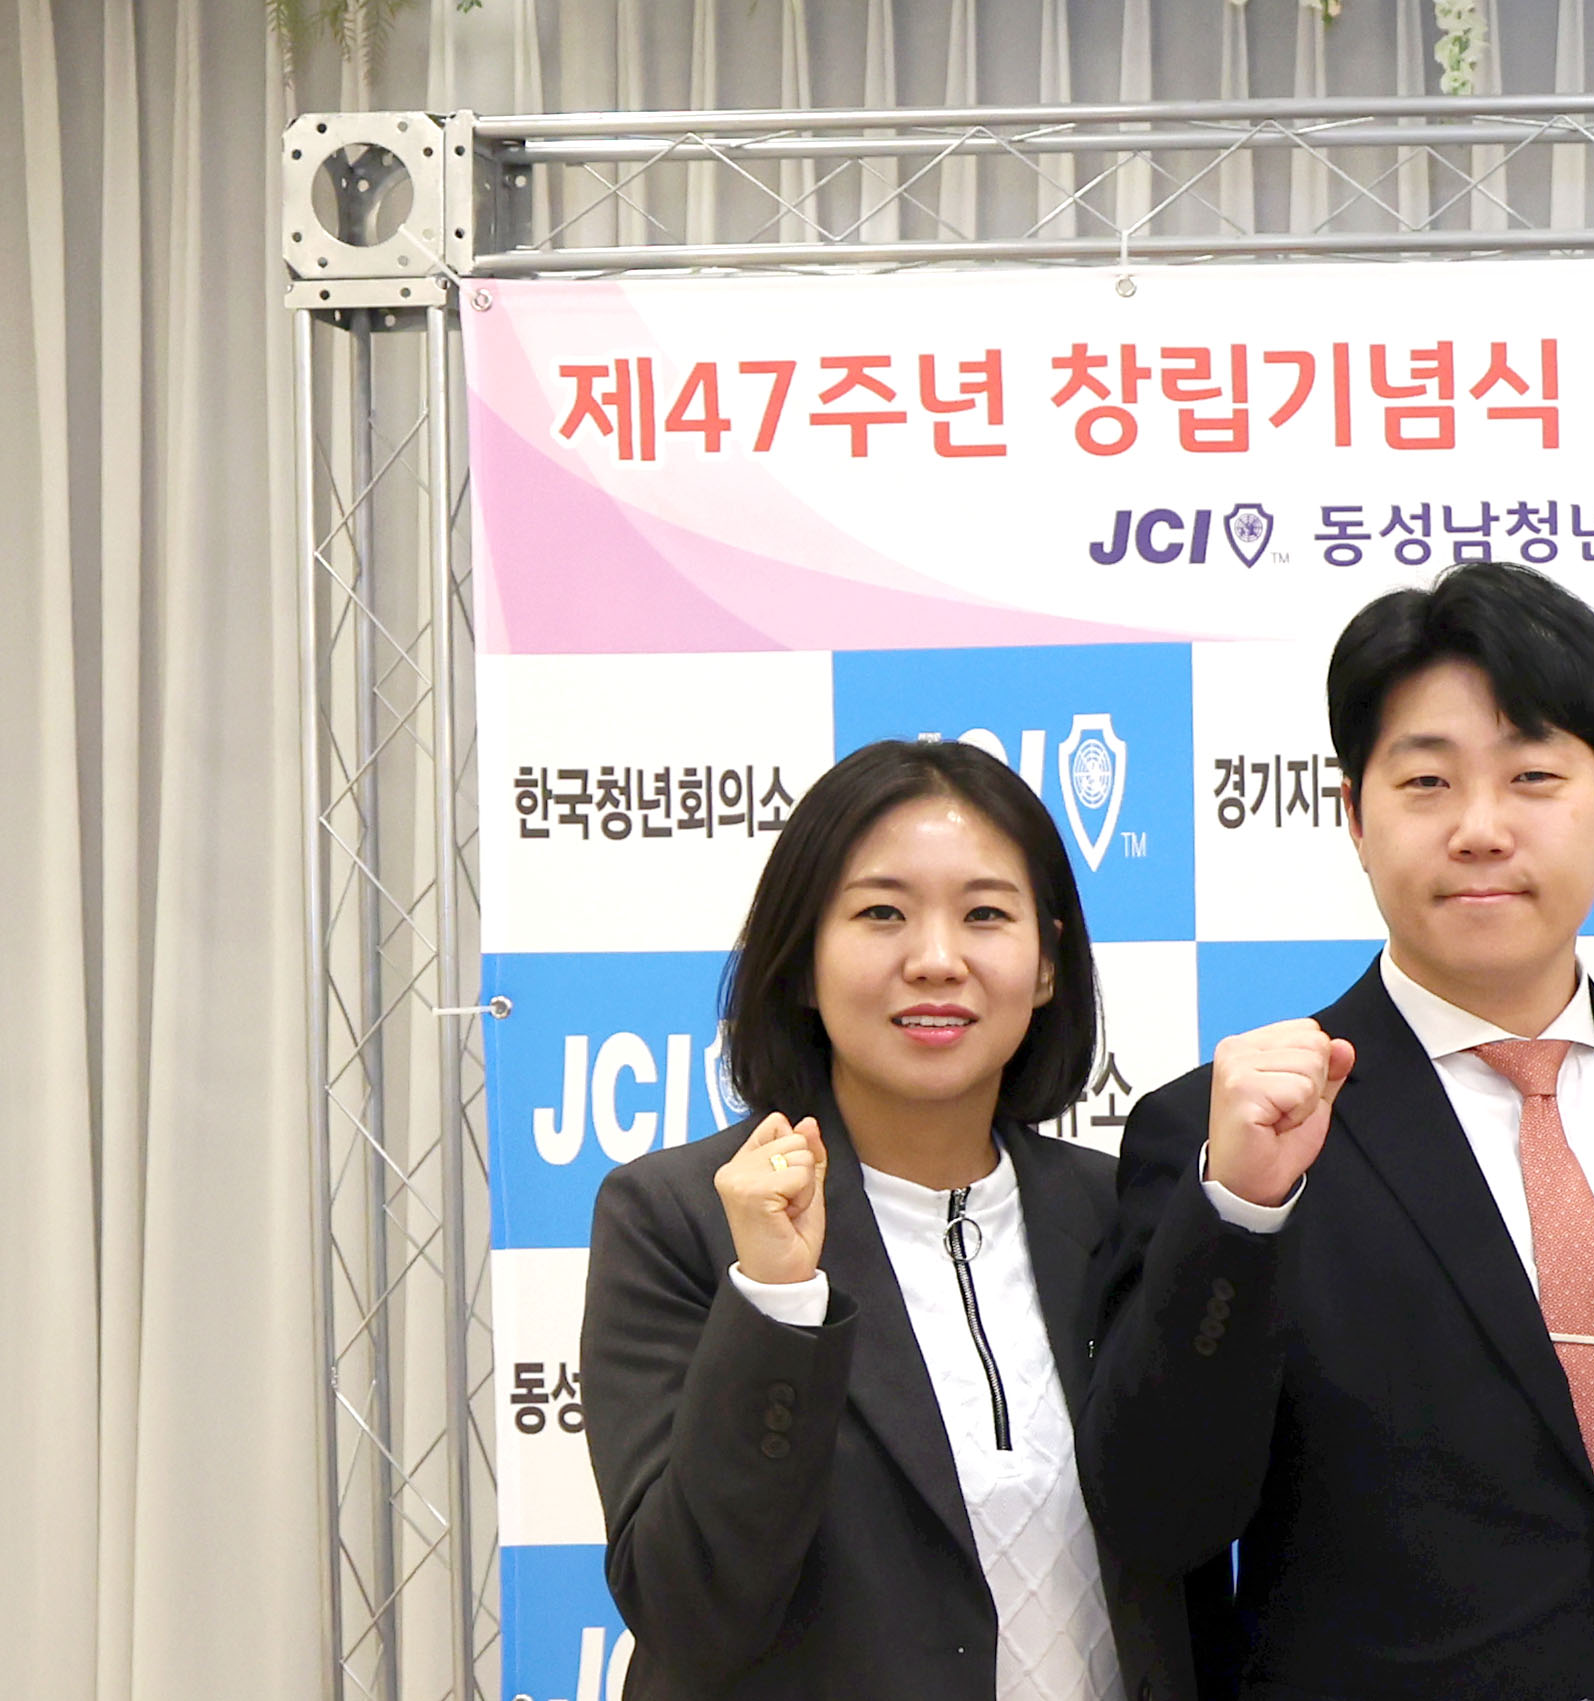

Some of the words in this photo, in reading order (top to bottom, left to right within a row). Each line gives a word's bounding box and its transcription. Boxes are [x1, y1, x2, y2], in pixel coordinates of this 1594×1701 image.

[557, 353, 1007, 461] 제47주년
[1051, 339, 1561, 456] 창립기념식
[1089, 508, 1212, 566] JCI
[514, 765, 795, 840] 한국청년회의소
[1120, 831, 1147, 858] TM
[532, 1031, 692, 1165] JCI
